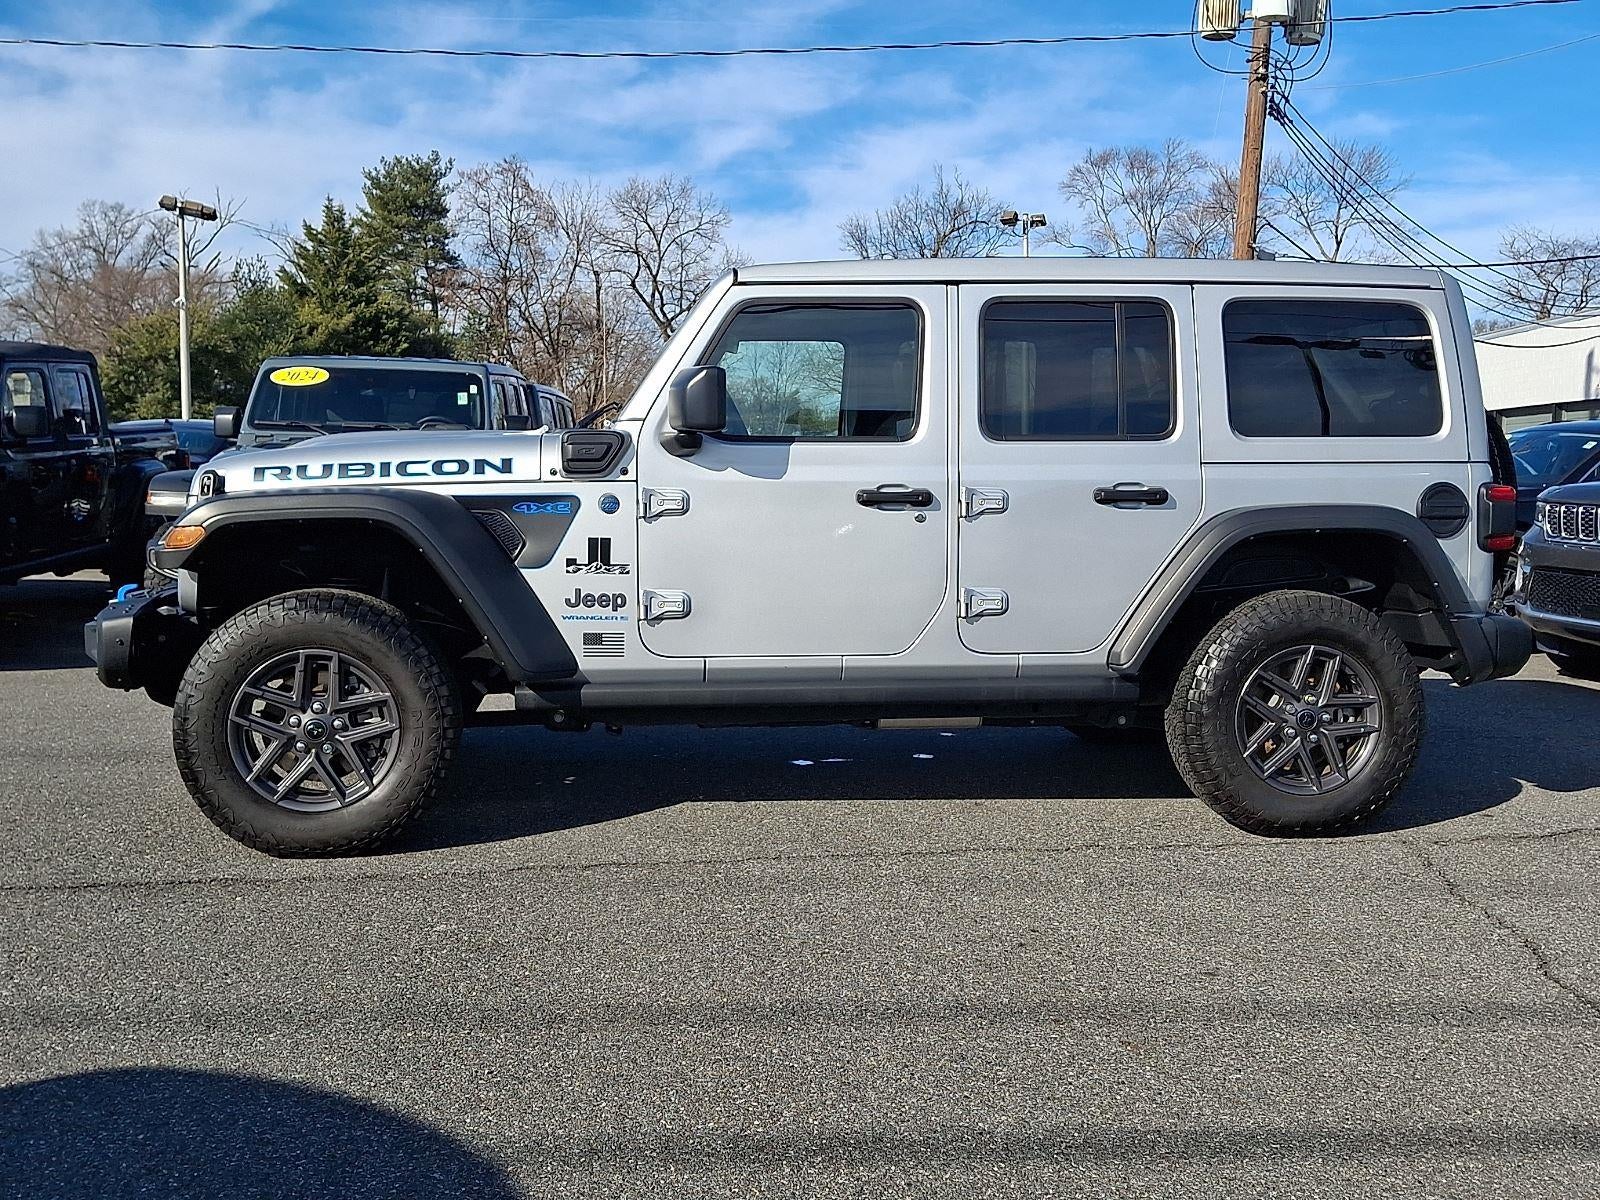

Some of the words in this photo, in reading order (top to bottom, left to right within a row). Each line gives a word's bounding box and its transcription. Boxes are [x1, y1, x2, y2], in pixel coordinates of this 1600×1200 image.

[281, 370, 320, 381] 2024
[253, 457, 514, 482] RUBICON
[564, 588, 627, 612] Jeep
